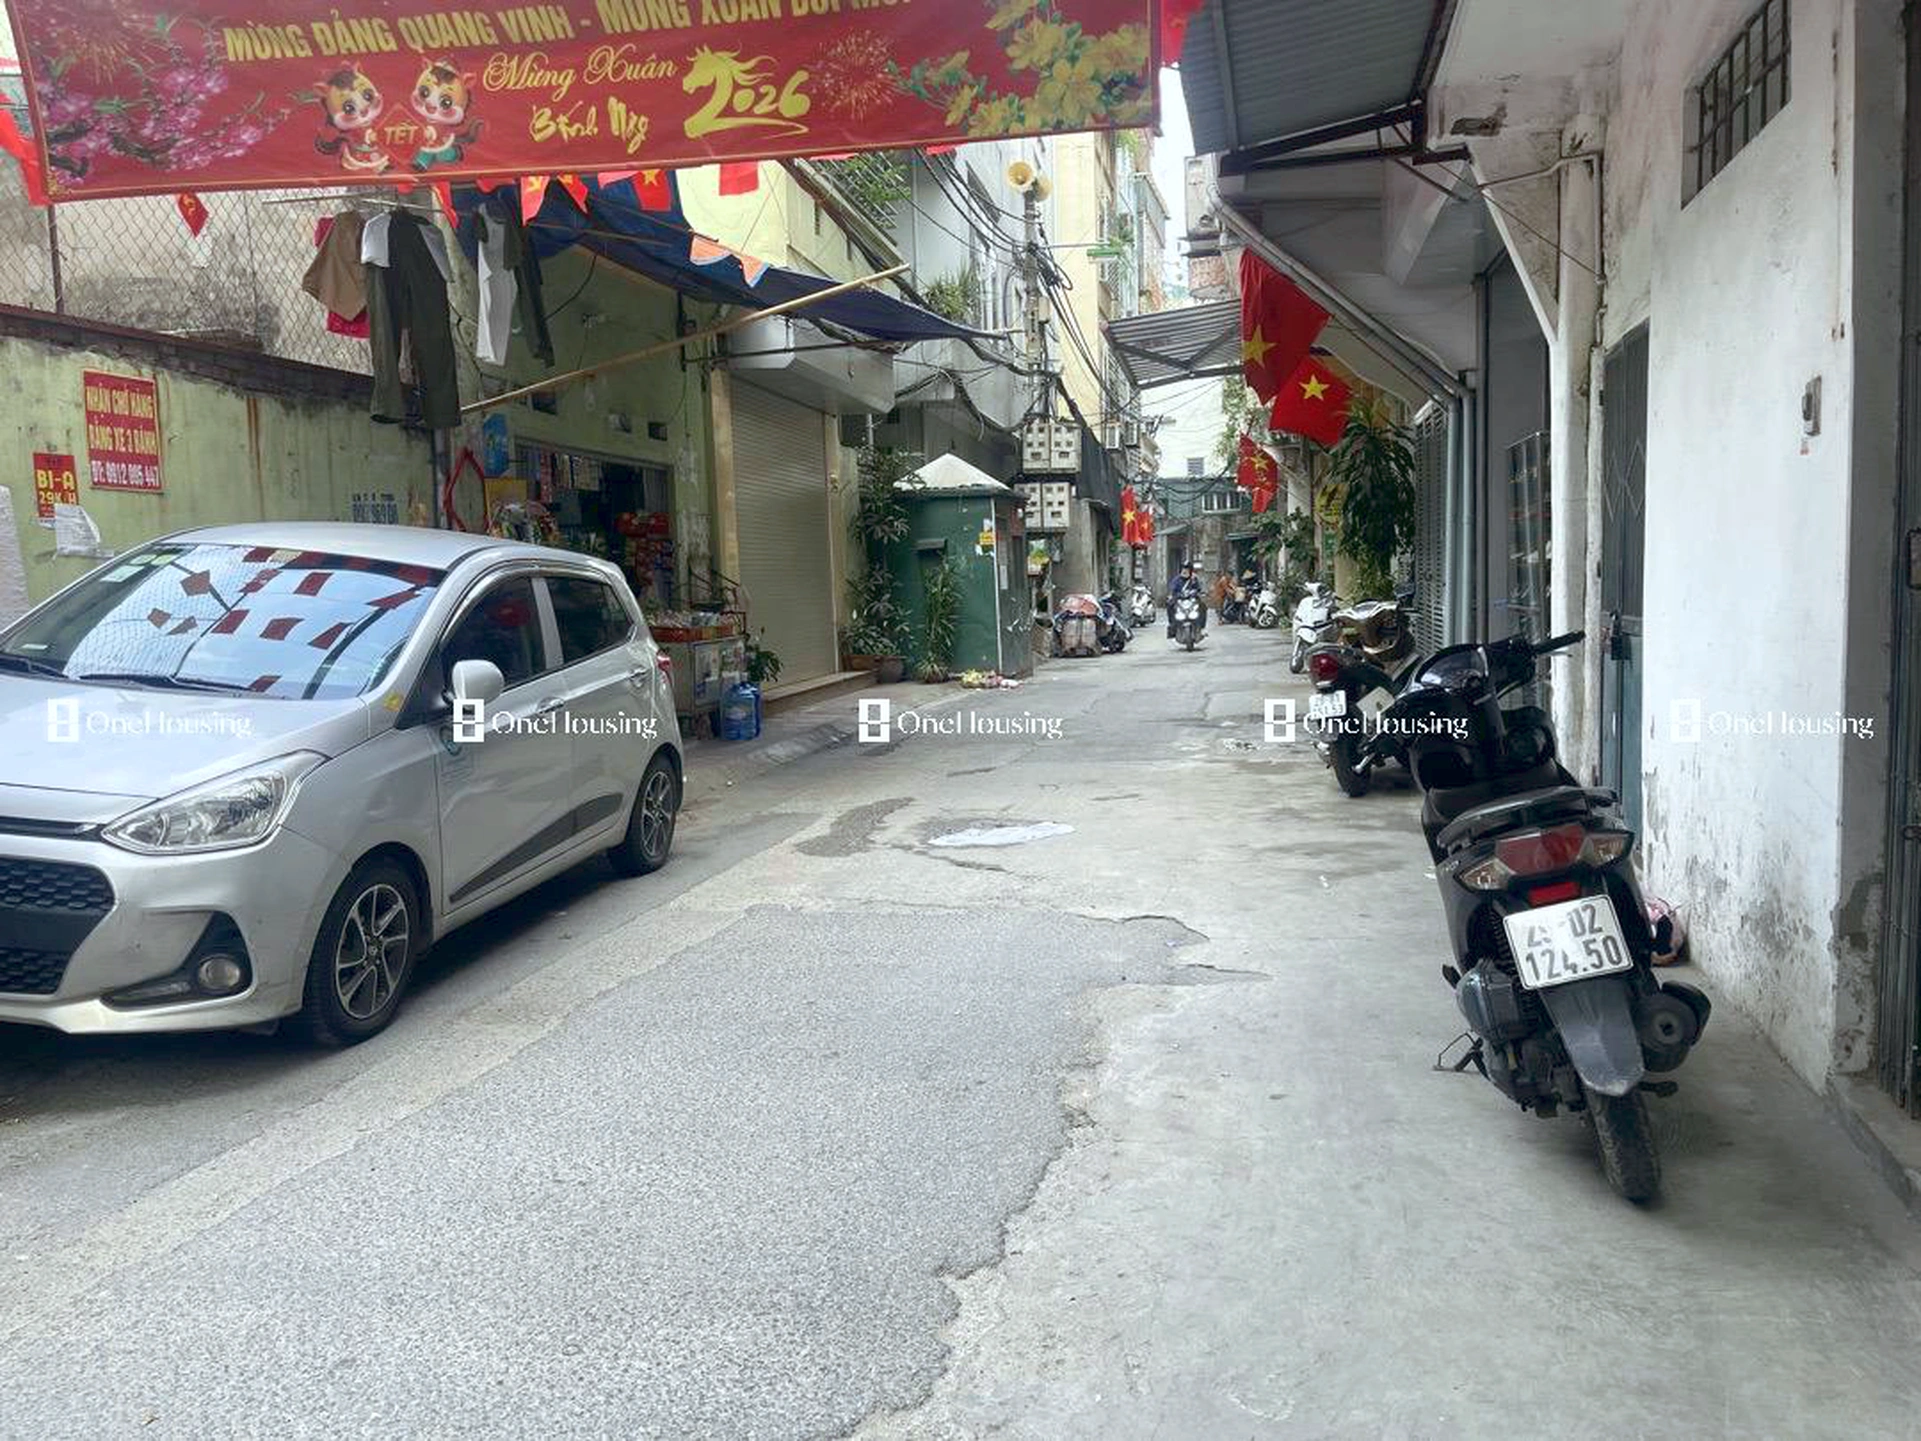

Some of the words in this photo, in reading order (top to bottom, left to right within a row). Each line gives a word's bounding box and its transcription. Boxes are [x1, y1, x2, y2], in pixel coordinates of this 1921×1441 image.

[311, 9, 398, 56] ĐẢNG
[398, 11, 499, 53] QUANG
[496, 5, 575, 43] VINH
[483, 52, 576, 101] Mừng
[584, 44, 678, 84] Xuân
